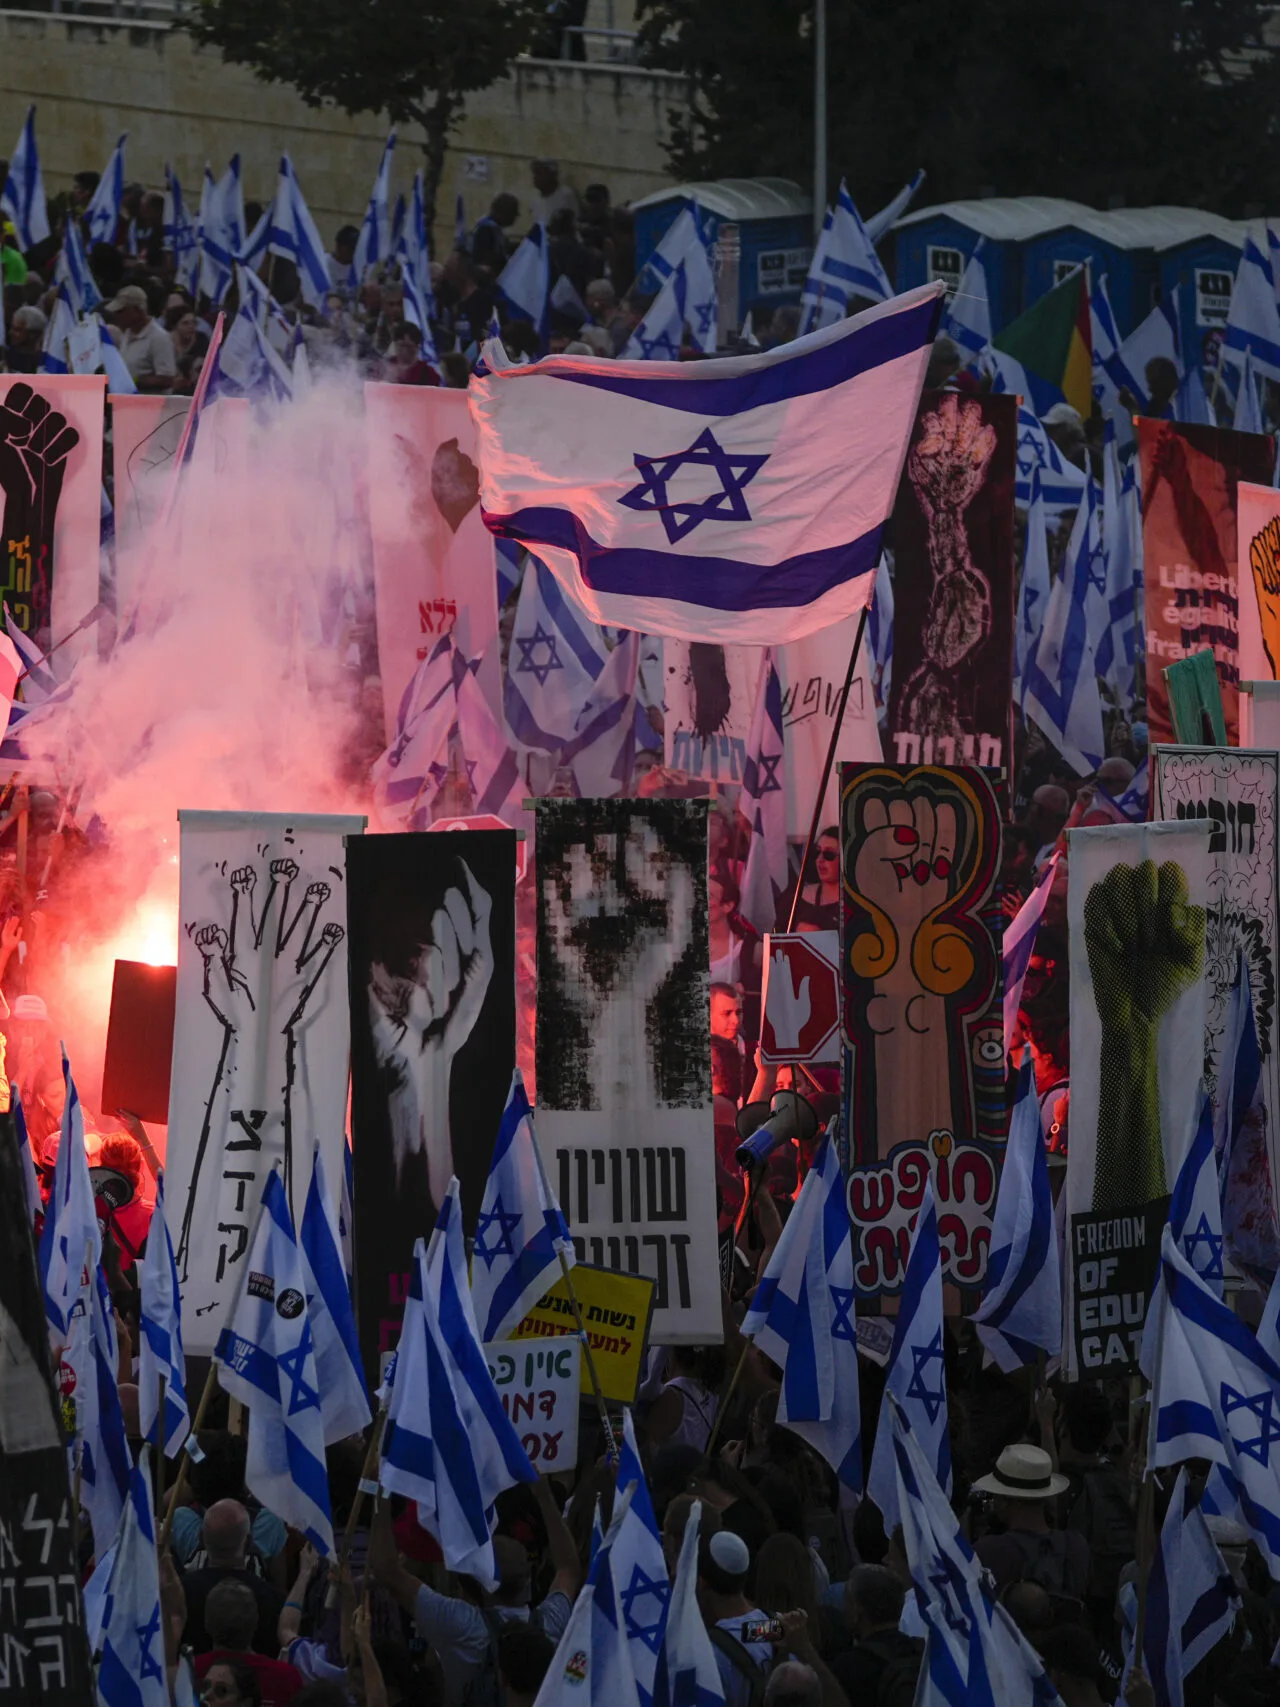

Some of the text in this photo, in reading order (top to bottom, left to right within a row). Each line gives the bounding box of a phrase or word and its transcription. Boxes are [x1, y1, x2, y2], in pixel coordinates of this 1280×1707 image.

[1159, 563, 1238, 600] Libert
[418, 597, 457, 634] ללא
[1163, 599, 1238, 634] égalit
[556, 1147, 687, 1224] שוויון
[850, 1134, 994, 1222] חופש
[857, 1213, 992, 1287] תרות
[1076, 1215, 1146, 1256] FREEDOM
[1079, 1256, 1119, 1293] OF
[586, 1304, 637, 1332] נשות
[1079, 1291, 1145, 1331] EDU
